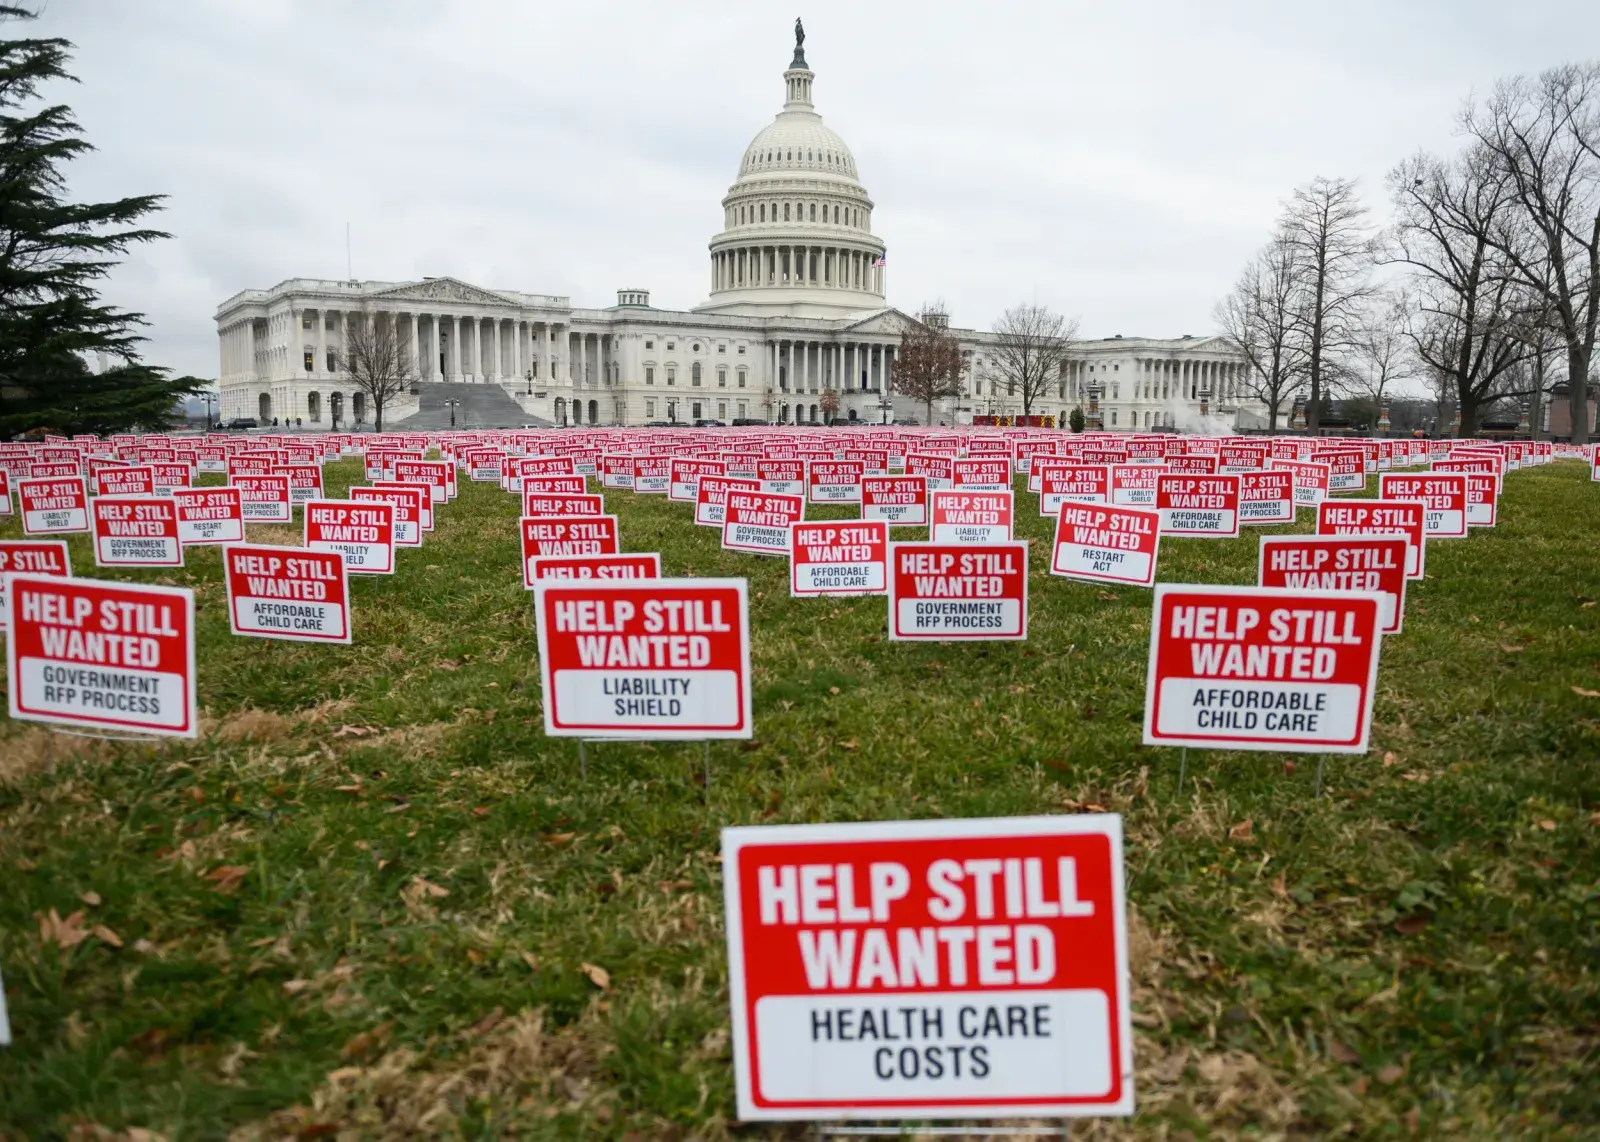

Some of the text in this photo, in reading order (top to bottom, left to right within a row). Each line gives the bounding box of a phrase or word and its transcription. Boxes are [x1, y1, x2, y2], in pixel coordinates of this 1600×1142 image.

[1222, 450, 1261, 459] HELP STILL
[1338, 455, 1361, 464] STILL
[547, 461, 570, 470] STILL
[675, 463, 720, 473] HELP STILL
[909, 458, 928, 466] HELP
[957, 464, 1005, 473] HELP STILL
[1226, 458, 1256, 466] WANTED
[296, 469, 317, 478] STILL
[398, 466, 419, 474] HELP
[421, 467, 443, 476] STILL
[813, 465, 860, 474] HELP STILL
[1046, 470, 1104, 481] HELP STILL
[1116, 469, 1138, 478] HELP
[1301, 466, 1326, 478] STILL
[101, 470, 149, 483] HELP STILL
[818, 475, 855, 484] WANTED
[962, 474, 999, 483] WANTED
[1259, 476, 1288, 488] STILL
[24, 483, 81, 497] HELP STILL
[107, 482, 145, 493] WANTED
[260, 480, 285, 490] STILL
[528, 482, 580, 491] HELP STILL
[703, 481, 726, 491] HELP
[866, 482, 922, 492] HELP STILL
[1052, 482, 1097, 492] WANTED
[1162, 480, 1234, 494] HELP STILL
[1388, 481, 1461, 494] HELP STILL
[32, 497, 76, 509] WANTED
[207, 493, 237, 506] STILL
[731, 496, 797, 513] HELP STILL
[872, 493, 915, 503] WANTED
[938, 497, 1007, 510] HELP STILL
[1170, 495, 1225, 508] WANTED
[98, 505, 172, 520] HELP STILL
[185, 506, 231, 519] WANTED
[533, 500, 597, 513] HELP STILL
[312, 509, 346, 524] HELP
[350, 510, 388, 526] STILL
[738, 510, 789, 527] WANTED
[946, 511, 998, 524] WANTED
[1065, 508, 1152, 534] HELP STILL
[1171, 512, 1222, 520] AFFORDABLE
[1325, 508, 1417, 526] HELP STILL
[108, 521, 165, 535] WANTED
[528, 524, 610, 539] HELP STILL
[737, 526, 786, 537] GOVERNMENT
[1172, 521, 1219, 529] CHILD CARE
[320, 527, 378, 541] WANTED
[752, 536, 786, 545] PROCESS
[798, 528, 881, 546] HELP STILL
[1074, 527, 1140, 549] WANTED
[111, 540, 165, 548] GOVERNMENT
[539, 541, 601, 556] WANTED
[130, 549, 166, 557] PROCESS
[808, 546, 871, 562] WANTED
[1083, 549, 1125, 563] RESTART
[1271, 549, 1396, 570] HELP STILL
[13, 551, 61, 571] STILL
[902, 554, 1017, 575] HELP STILL
[1093, 562, 1111, 571] ACT
[234, 556, 337, 580] HELP STILL
[811, 567, 869, 576] AFFORDABLE
[814, 577, 867, 587] CHILD CARE
[915, 577, 1003, 596] WANTED
[1285, 572, 1380, 591] WANTED
[248, 577, 326, 600] WANTED
[22, 592, 179, 637] HELP STILL
[254, 603, 324, 618] AFFORDABLE
[916, 602, 1002, 614] GOVERNMENT
[258, 616, 323, 630] CHILD CARE
[554, 600, 730, 633] HELP STILL
[916, 616, 1002, 627] RFP PROCESS
[1171, 606, 1362, 645] HELP STILL
[40, 626, 160, 668] WANTED
[576, 635, 710, 667] WANTED
[1191, 643, 1337, 679] WANTED
[43, 666, 160, 694] GOVERNMENT
[604, 678, 691, 695] LIABILITY
[44, 686, 160, 714] RFP PROCESS
[1193, 689, 1327, 711] AFFORDABLE
[615, 699, 680, 716] SHIELD
[1197, 710, 1318, 731] CHILD CARE
[758, 856, 1095, 925] HELP STILL
[798, 924, 1056, 989] WANTED
[811, 1005, 1051, 1041] HEALTH CARE
[875, 1045, 990, 1080] COSTS
